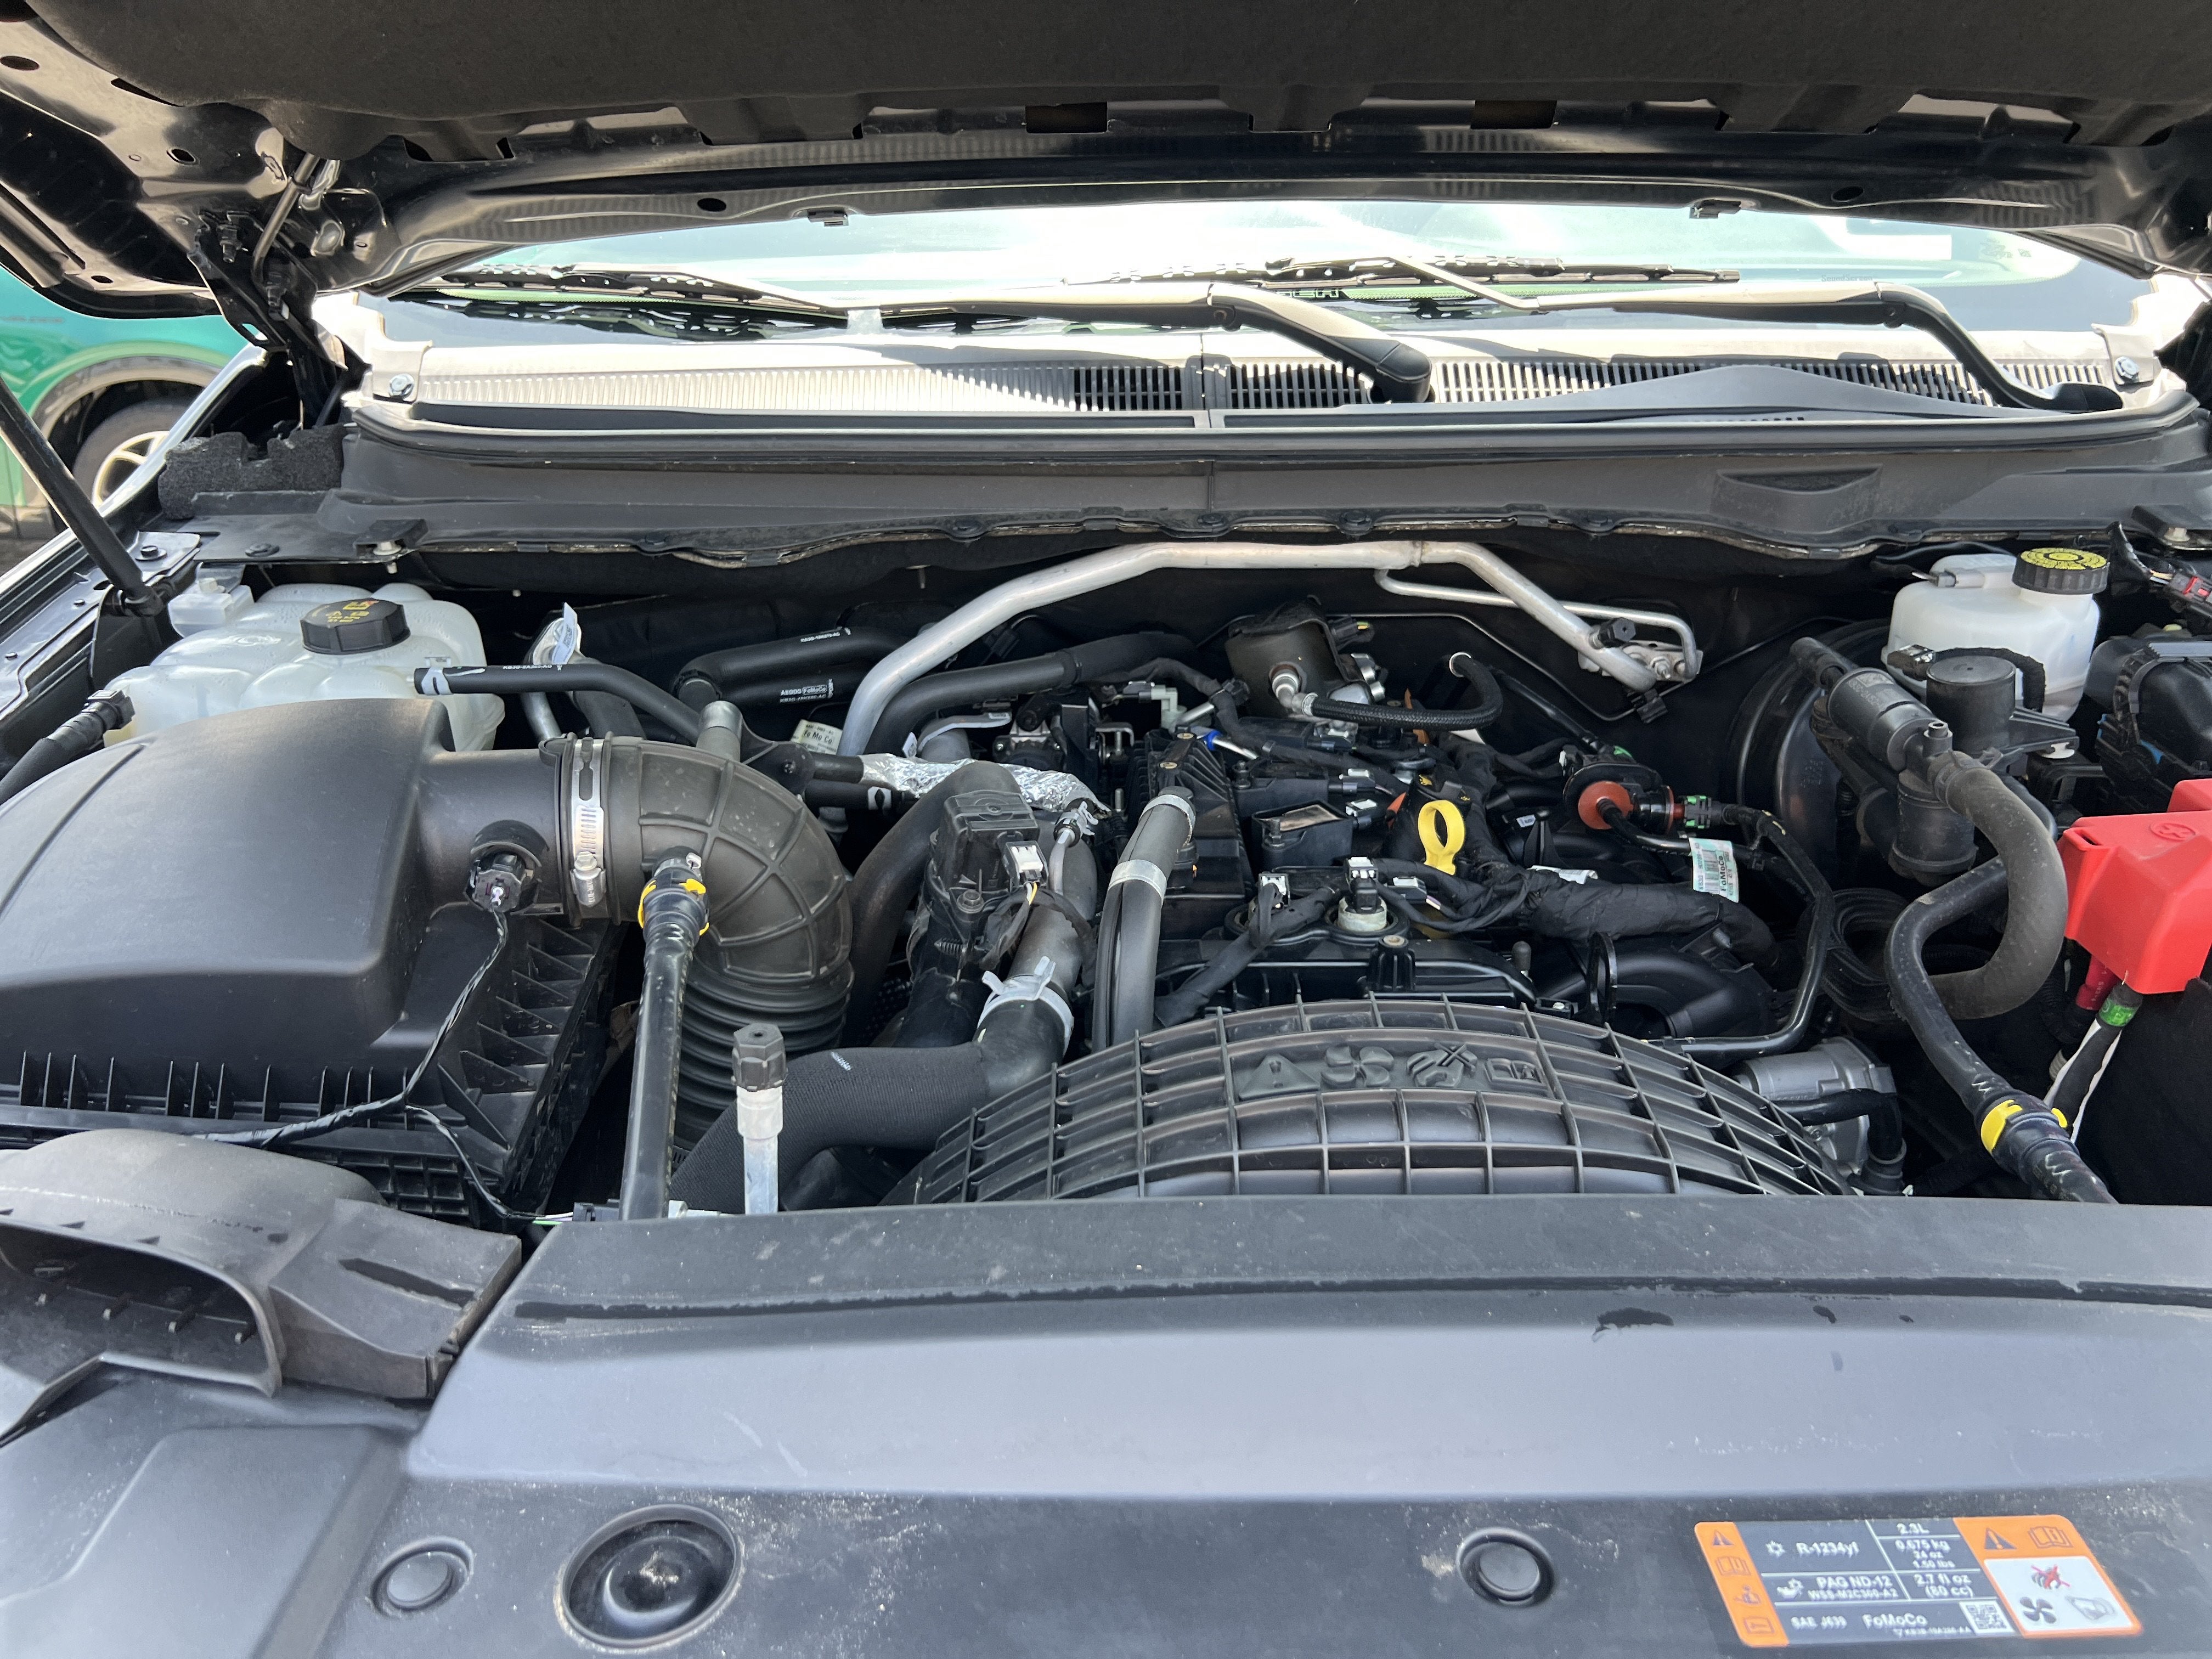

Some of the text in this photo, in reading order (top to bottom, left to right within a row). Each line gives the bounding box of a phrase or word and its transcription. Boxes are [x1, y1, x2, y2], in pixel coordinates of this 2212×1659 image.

[1718, 856, 1726, 891] FoMoCo
[1897, 1523, 1930, 1534] 2.3L
[1796, 1541, 1860, 1558] R-1234yf
[1931, 1539, 1951, 1553] kg
[1816, 1575, 1893, 1589] PAG ND-12
[1914, 1573, 1934, 1587] 2.7
[1952, 1575, 1972, 1586] oz
[1950, 1585, 1973, 1598] cc)
[1791, 1616, 1818, 1629] SAE
[1863, 1612, 1928, 1629] FoMoCo
